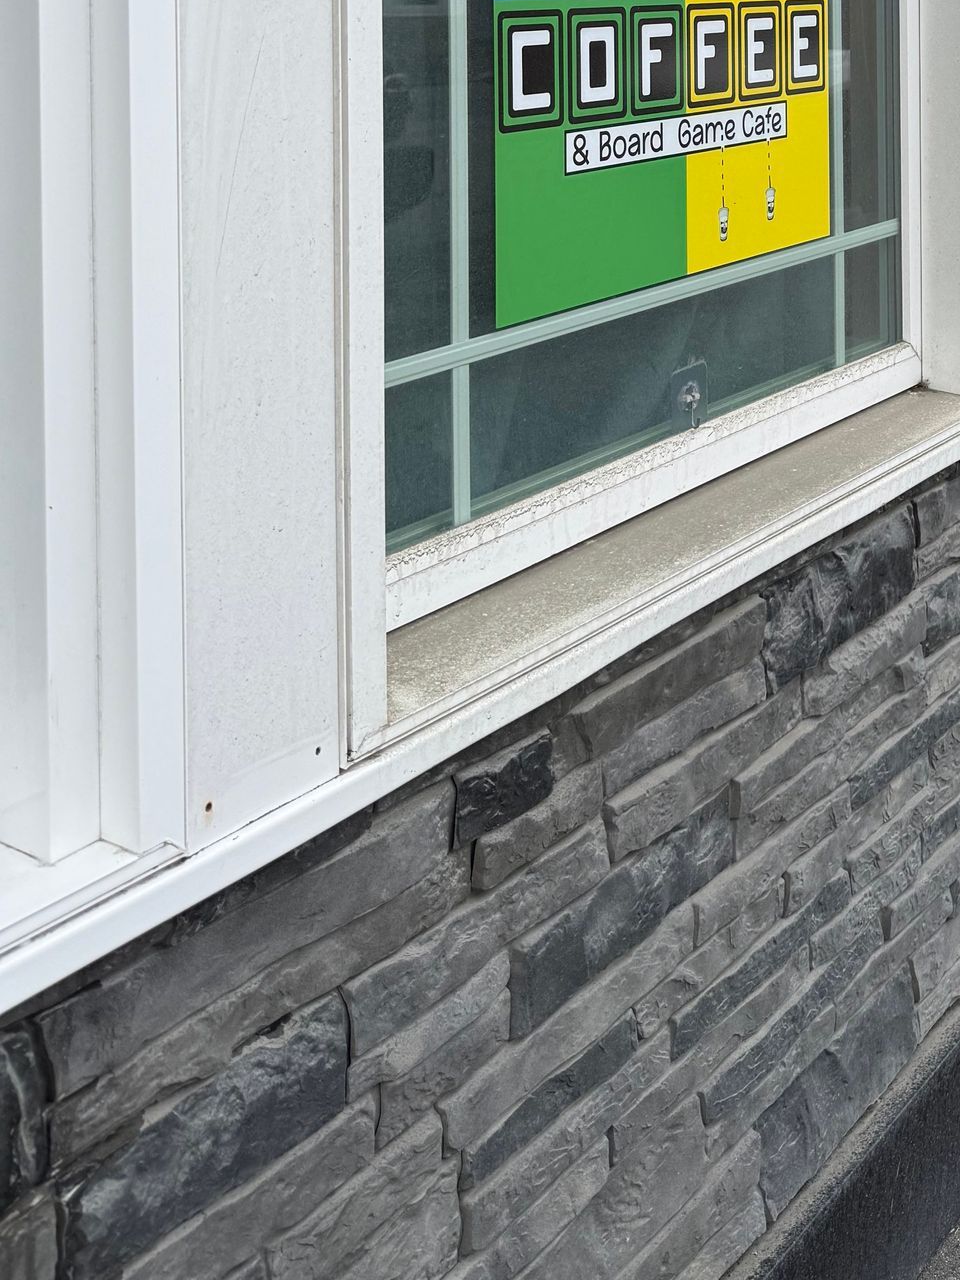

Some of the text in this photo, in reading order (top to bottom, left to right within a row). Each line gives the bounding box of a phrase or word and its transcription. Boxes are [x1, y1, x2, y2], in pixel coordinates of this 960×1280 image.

[511, 14, 818, 112] COFFEE
[572, 106, 782, 167] & Board Game Cafe
